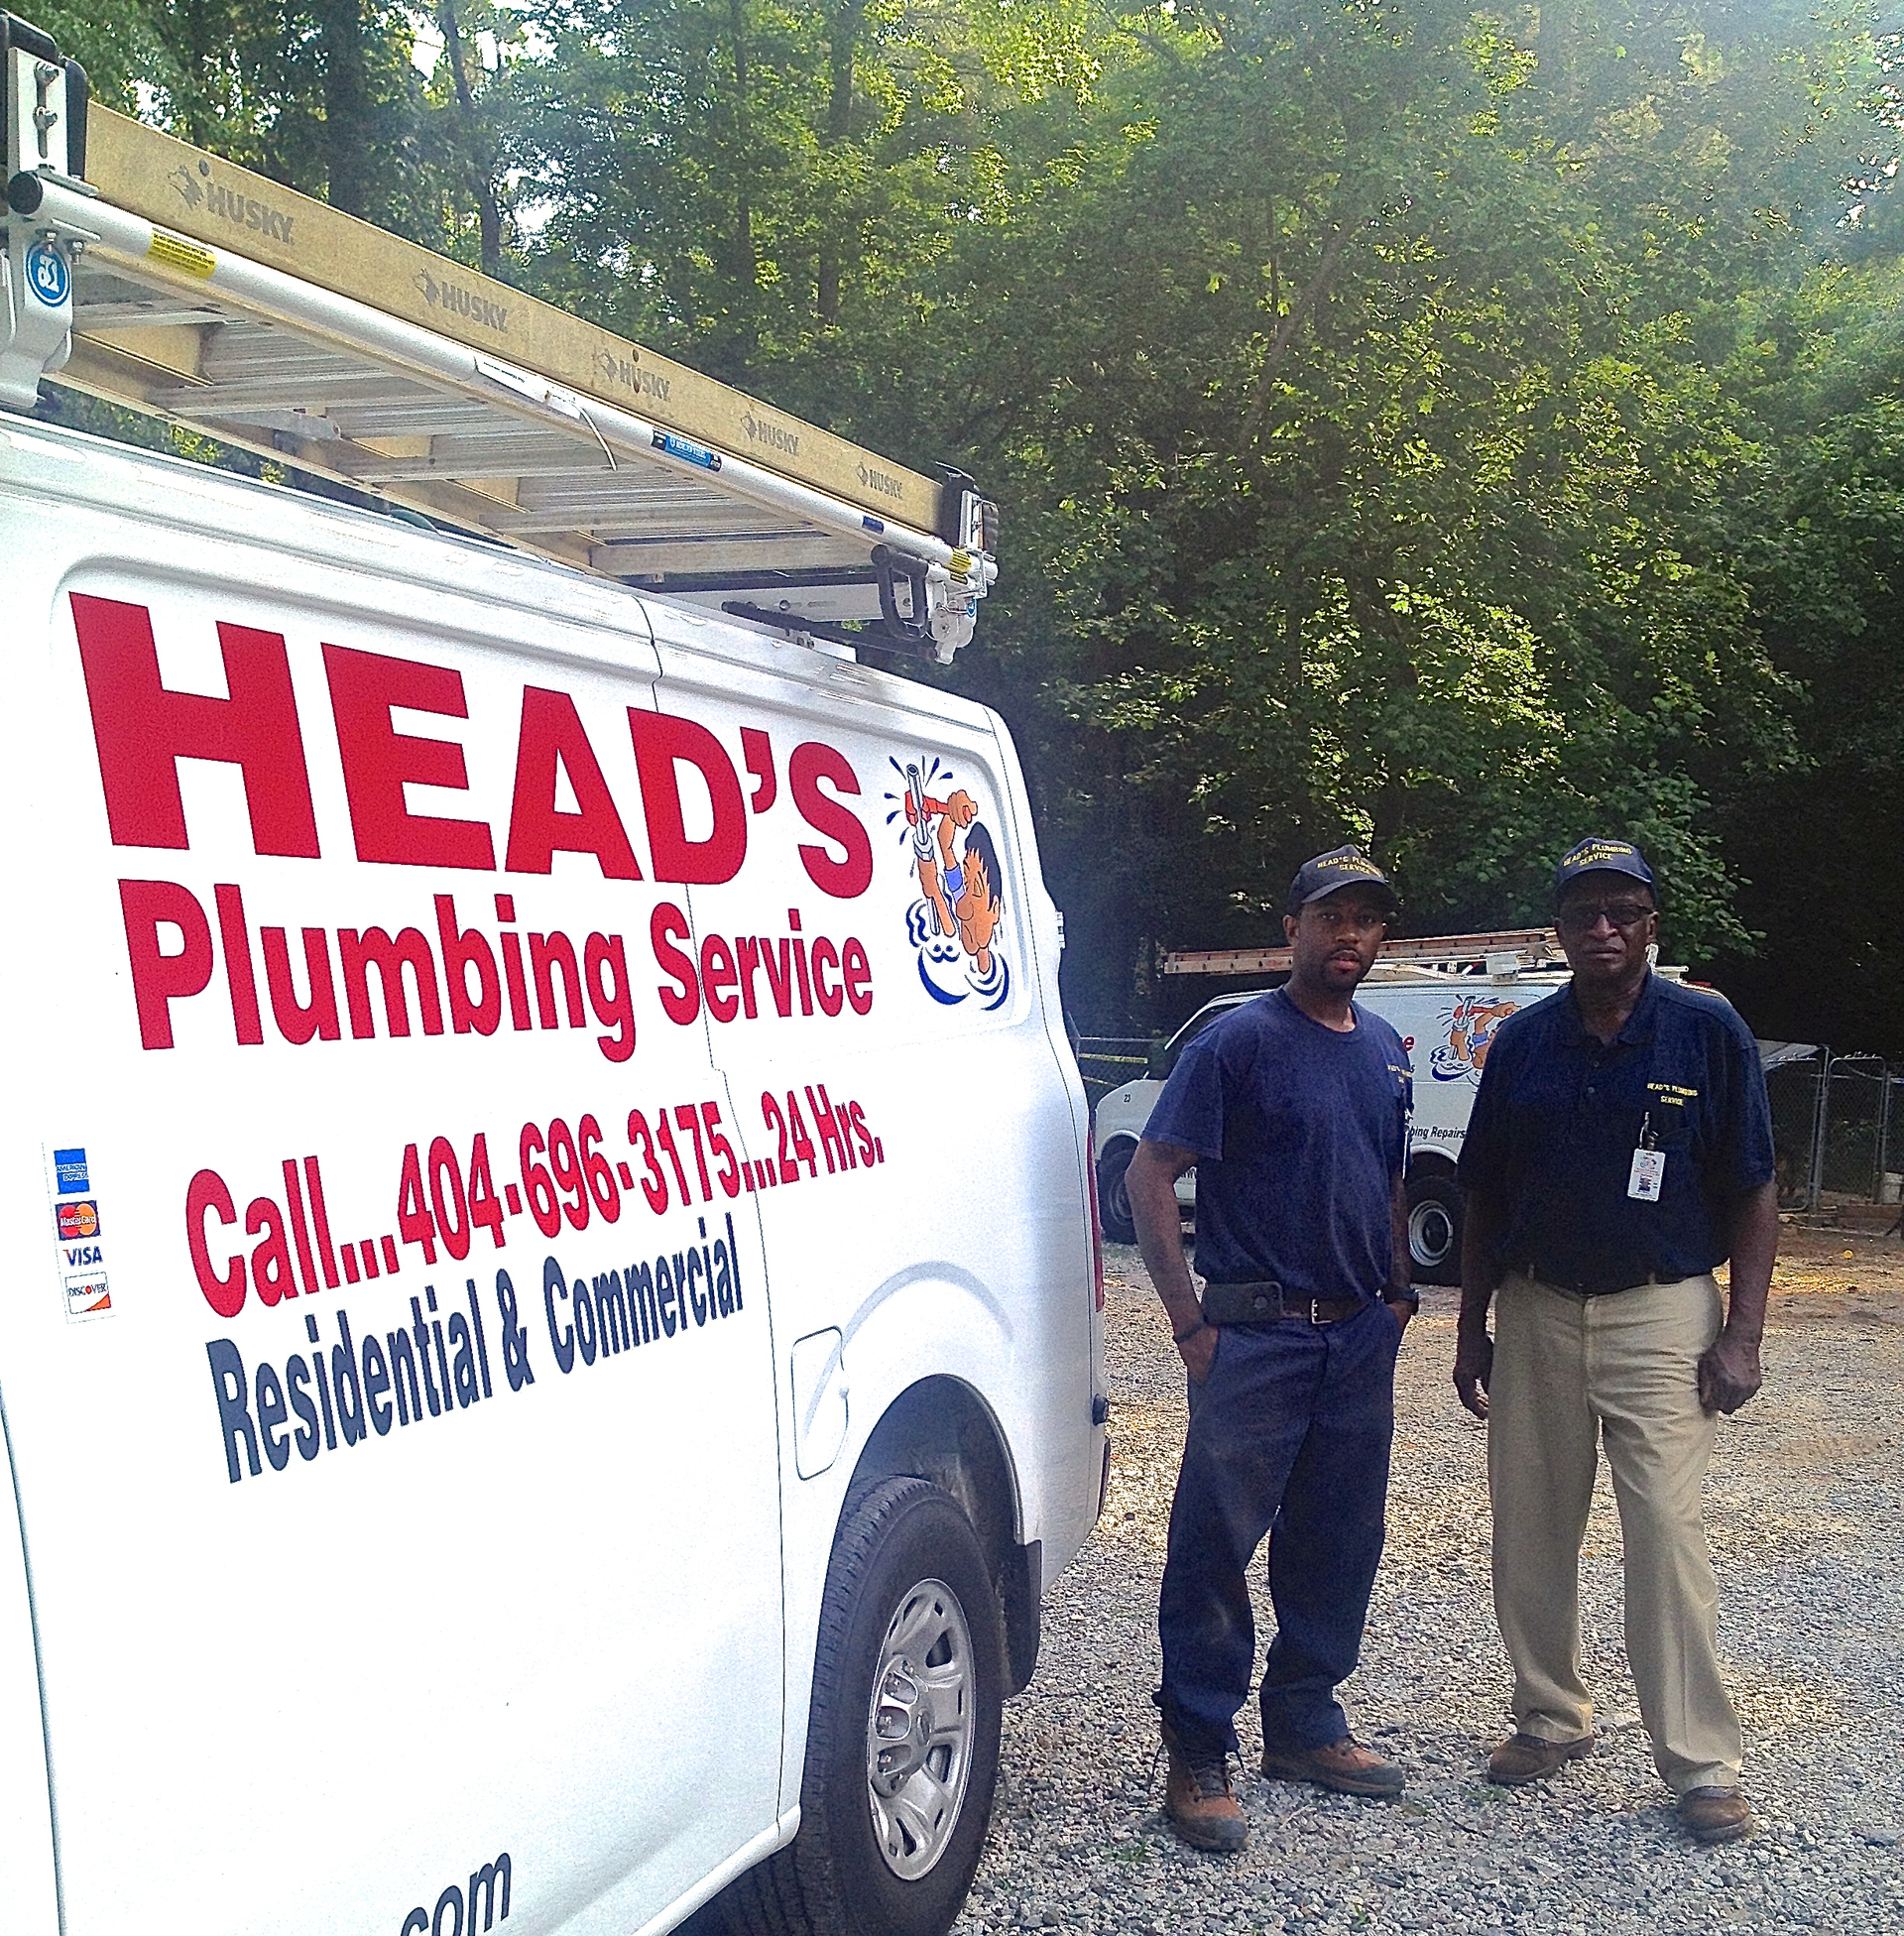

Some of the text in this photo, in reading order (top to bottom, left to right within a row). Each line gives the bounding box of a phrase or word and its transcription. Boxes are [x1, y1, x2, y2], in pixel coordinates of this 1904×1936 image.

[206, 182, 294, 245] HUSKY
[441, 282, 507, 332] HUSKY
[619, 360, 670, 401] HUSKY
[758, 420, 799, 456] HUSKY
[869, 469, 902, 499] HUSKY
[69, 591, 874, 898] HEAD'S
[1317, 855, 1349, 869] HEAD'S
[1579, 852, 1612, 867] SERVICE
[118, 879, 874, 1062] Plumbing Service
[804, 1084, 885, 1174] Hrs.
[1430, 1126, 1466, 1141] Repairs
[60, 1214, 96, 1227] MasterCard
[62, 1246, 103, 1266] VISA
[68, 1283, 107, 1296] DISCOVER
[205, 1211, 744, 1484] Residential & Commercial
